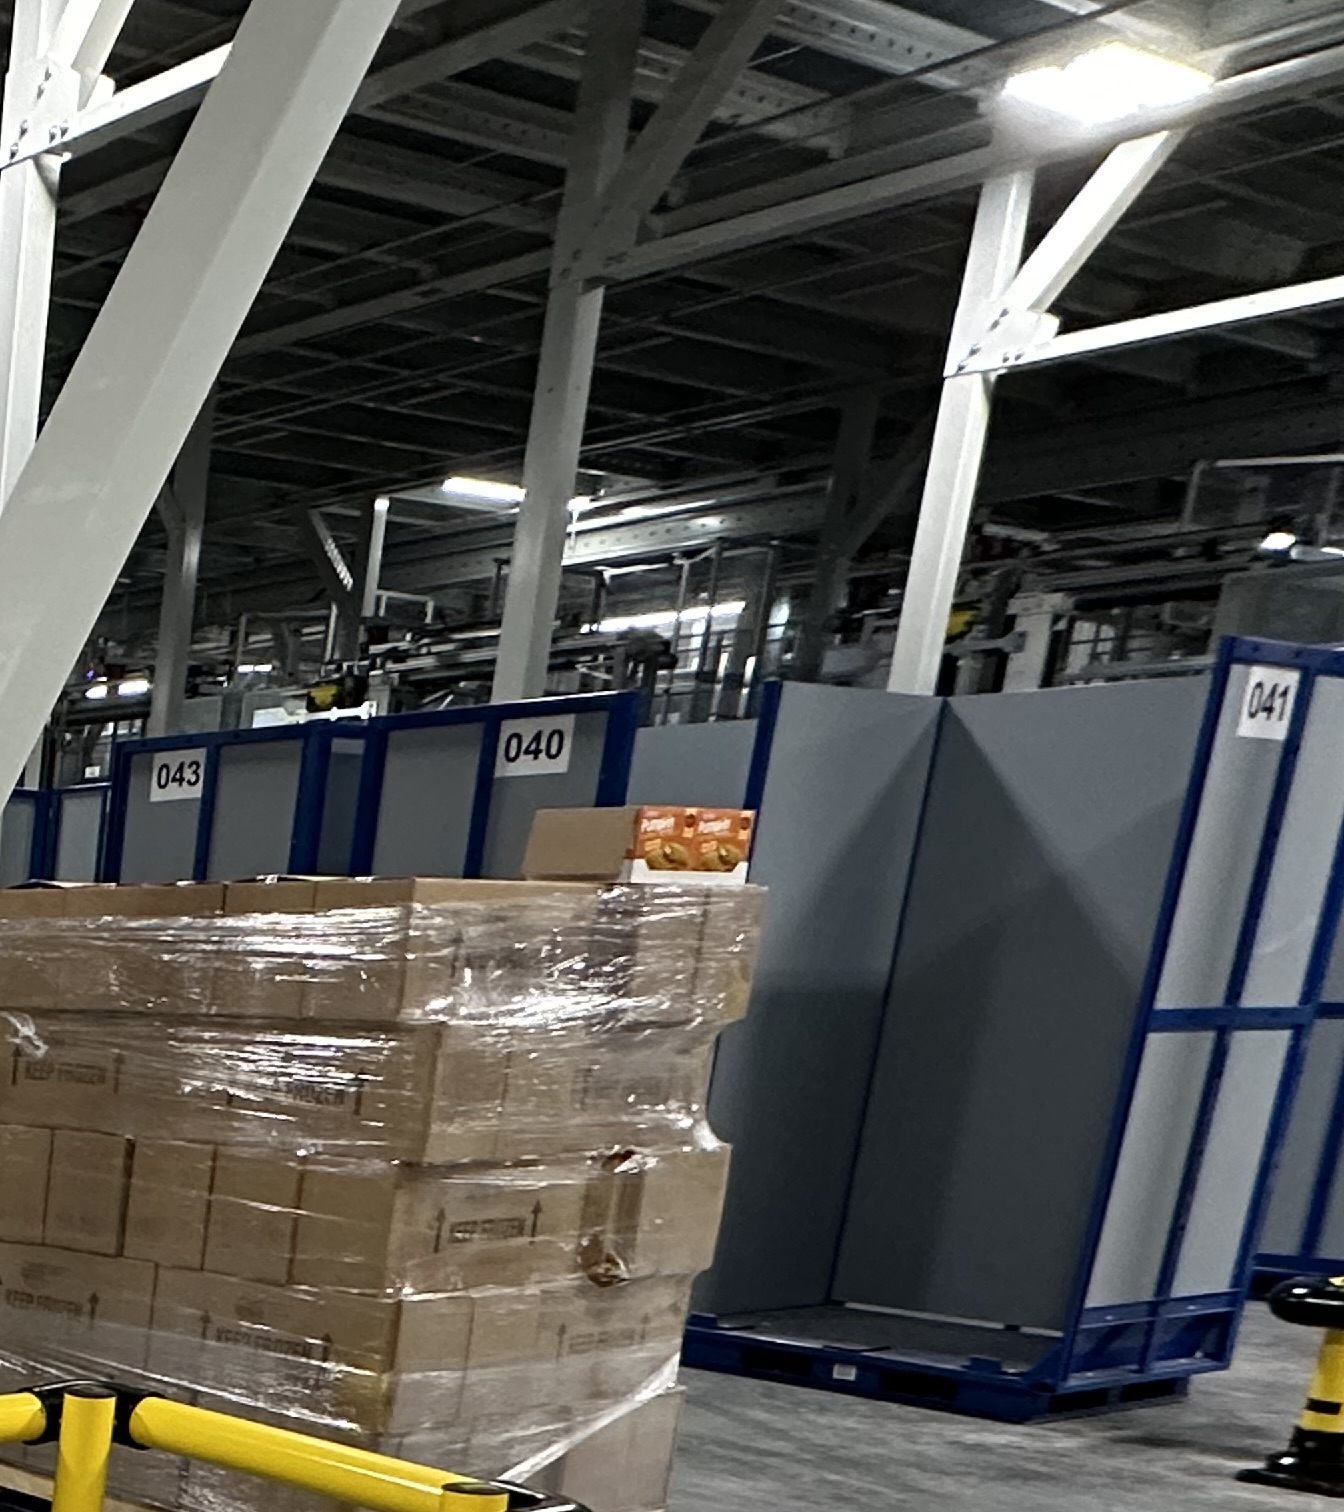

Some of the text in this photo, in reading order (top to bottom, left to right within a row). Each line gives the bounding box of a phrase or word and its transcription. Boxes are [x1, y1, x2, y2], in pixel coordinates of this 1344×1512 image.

[1248, 681, 1290, 721] 041
[504, 728, 564, 763] 040
[157, 760, 201, 789] 043
